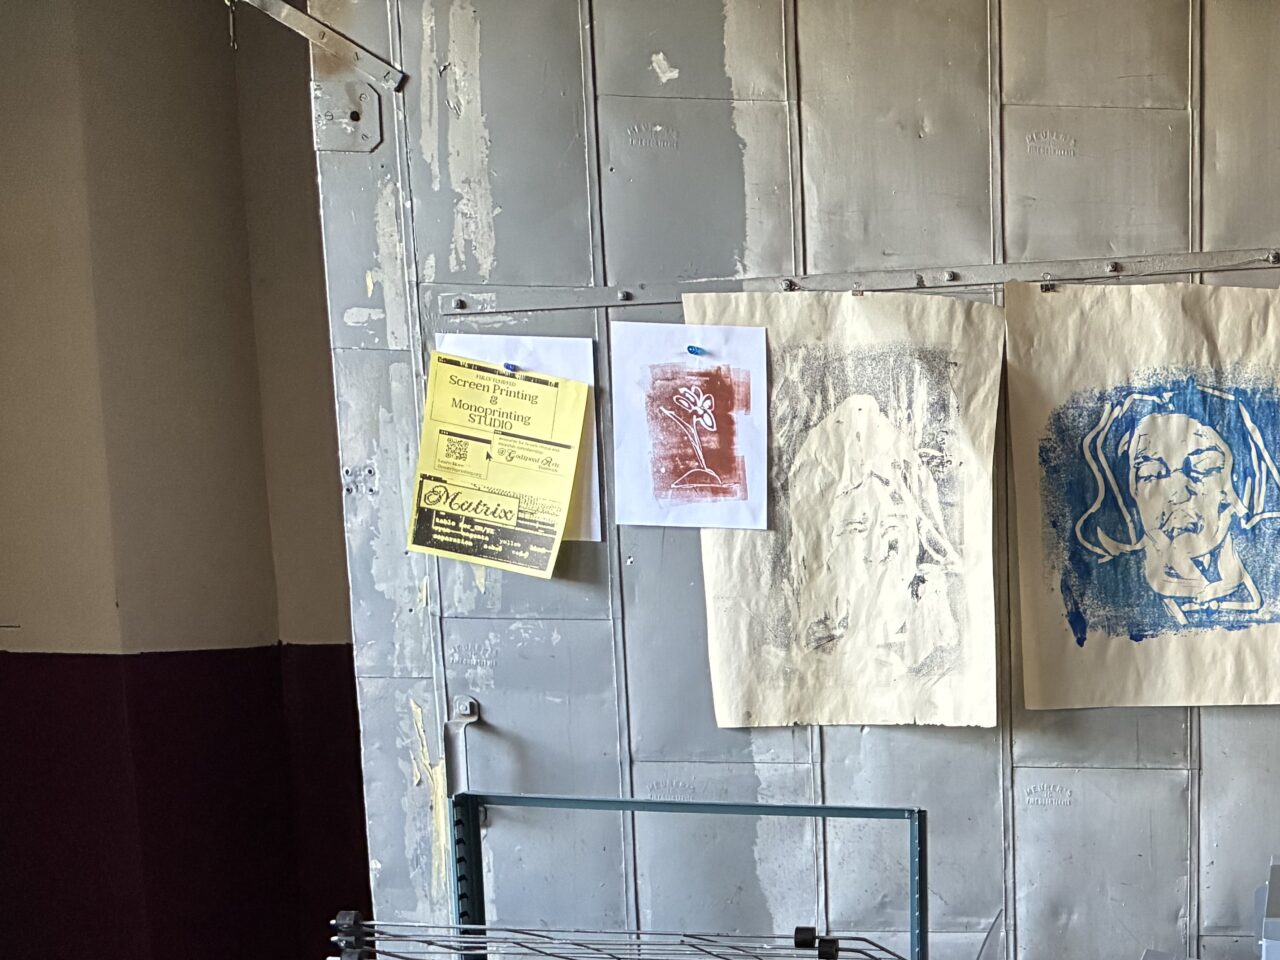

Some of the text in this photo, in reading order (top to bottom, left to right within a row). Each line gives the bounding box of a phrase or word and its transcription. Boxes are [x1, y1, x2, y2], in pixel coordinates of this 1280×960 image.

[449, 374, 539, 405] Screen Printing
[451, 397, 532, 426] Monoprinting
[468, 413, 513, 431] STUDIO
[424, 485, 515, 521] Matrix
